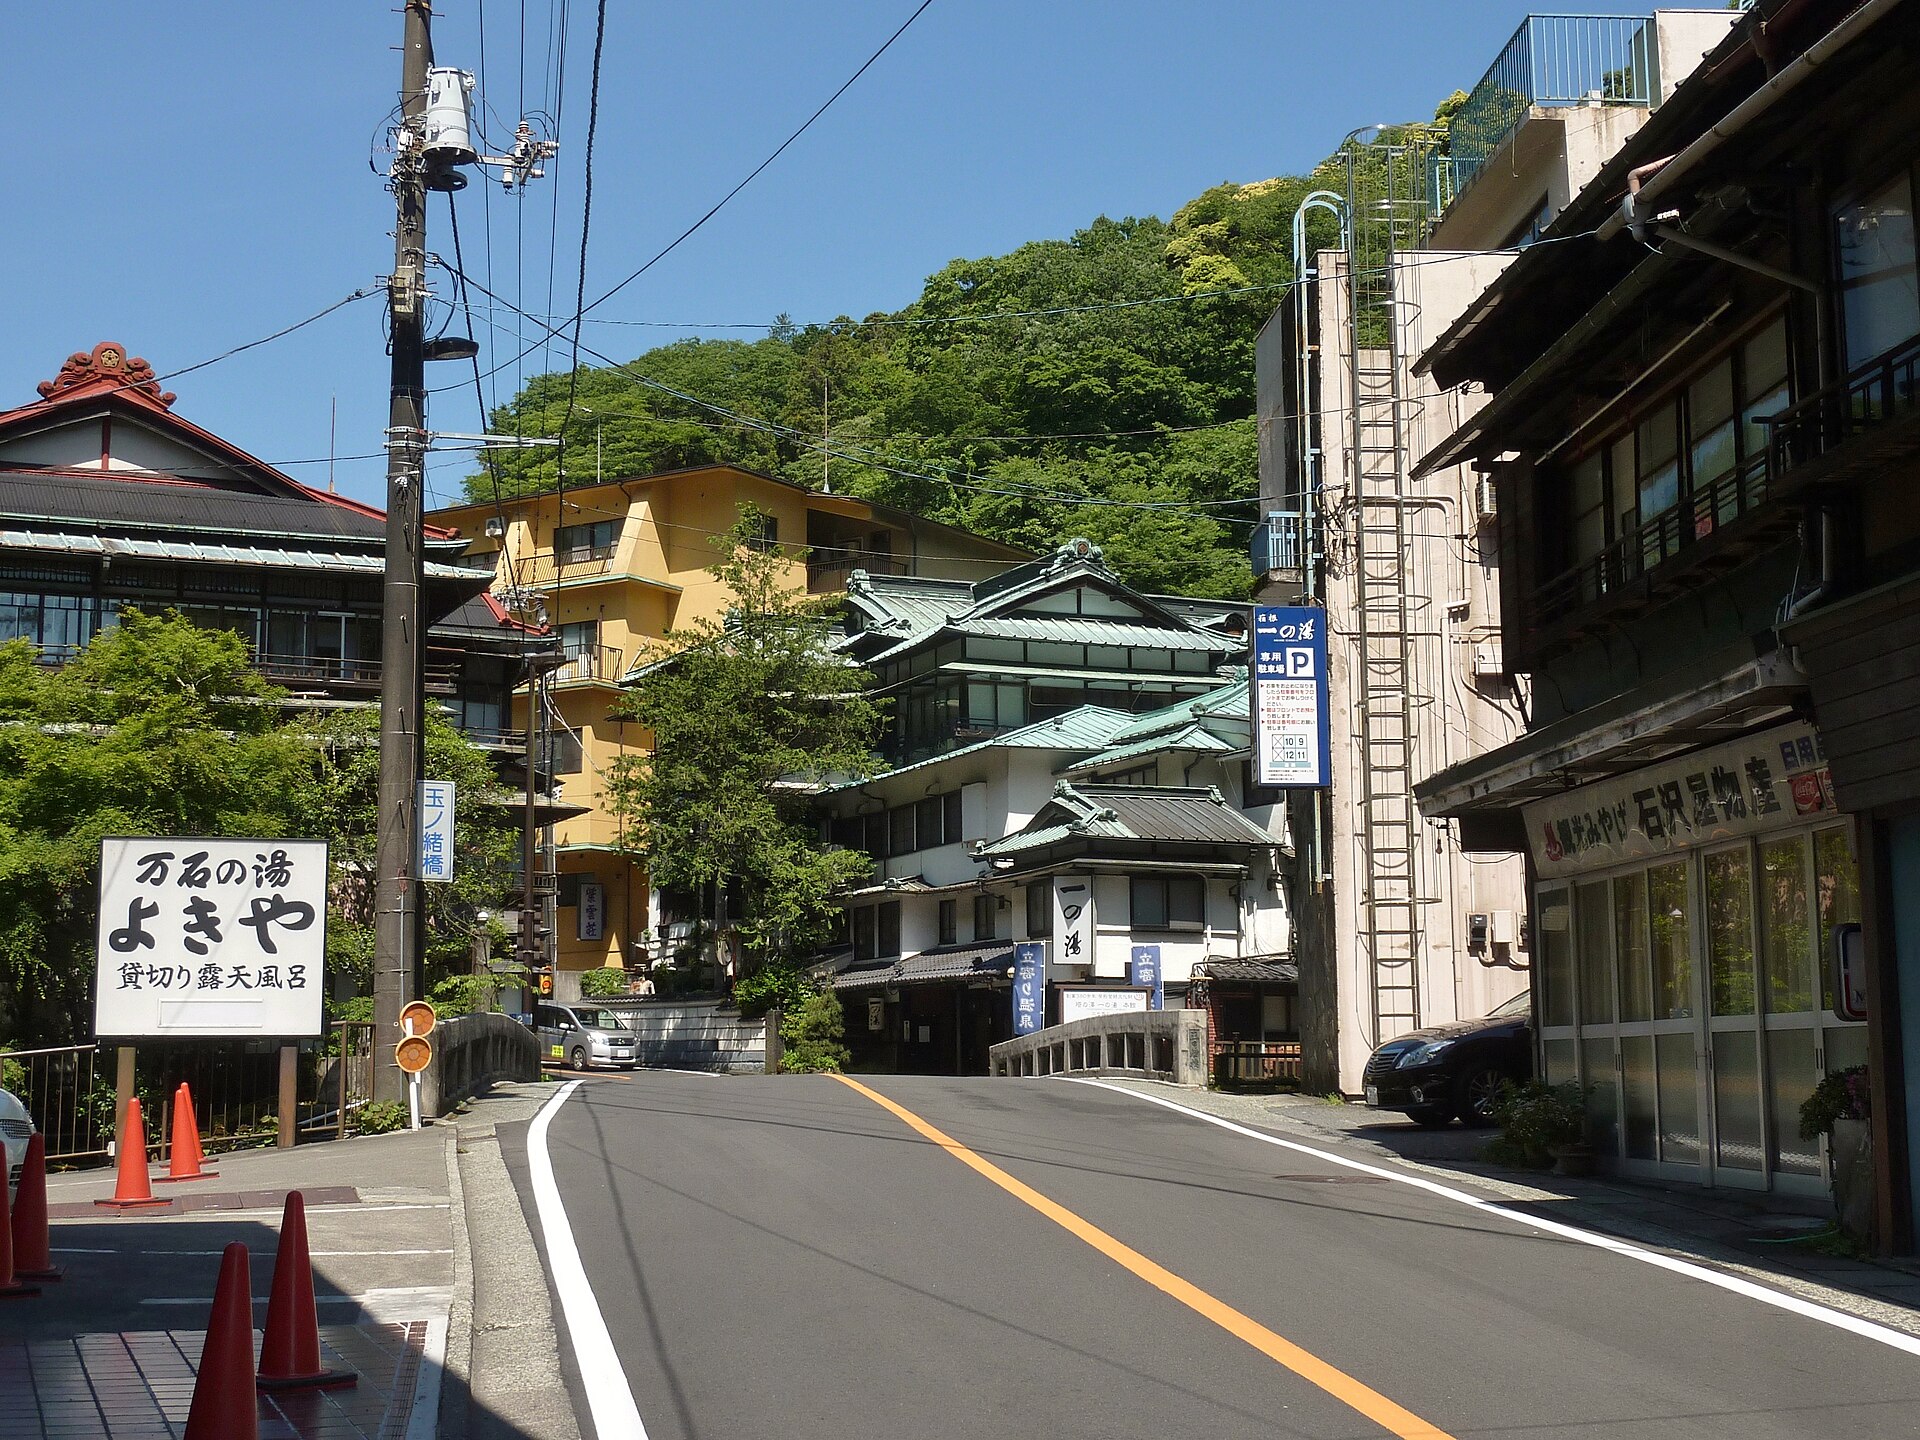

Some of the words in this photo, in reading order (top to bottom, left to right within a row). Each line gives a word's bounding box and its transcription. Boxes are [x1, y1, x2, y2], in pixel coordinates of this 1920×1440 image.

[1257, 618, 1315, 640] 一の湯
[1260, 651, 1281, 662] 専用
[1292, 652, 1309, 674] P
[1257, 664, 1285, 674] 駐車場
[1285, 737, 1294, 746] 10
[1298, 737, 1304, 746] 9
[1285, 751, 1295, 759] 12
[1297, 751, 1306, 759] 11
[422, 788, 445, 875] 玉ノ緒橋
[135, 850, 294, 888] 万石の湯
[108, 893, 316, 955] よきや
[1060, 884, 1086, 958] 一の湯
[116, 962, 306, 990] 貸切り露天風呂
